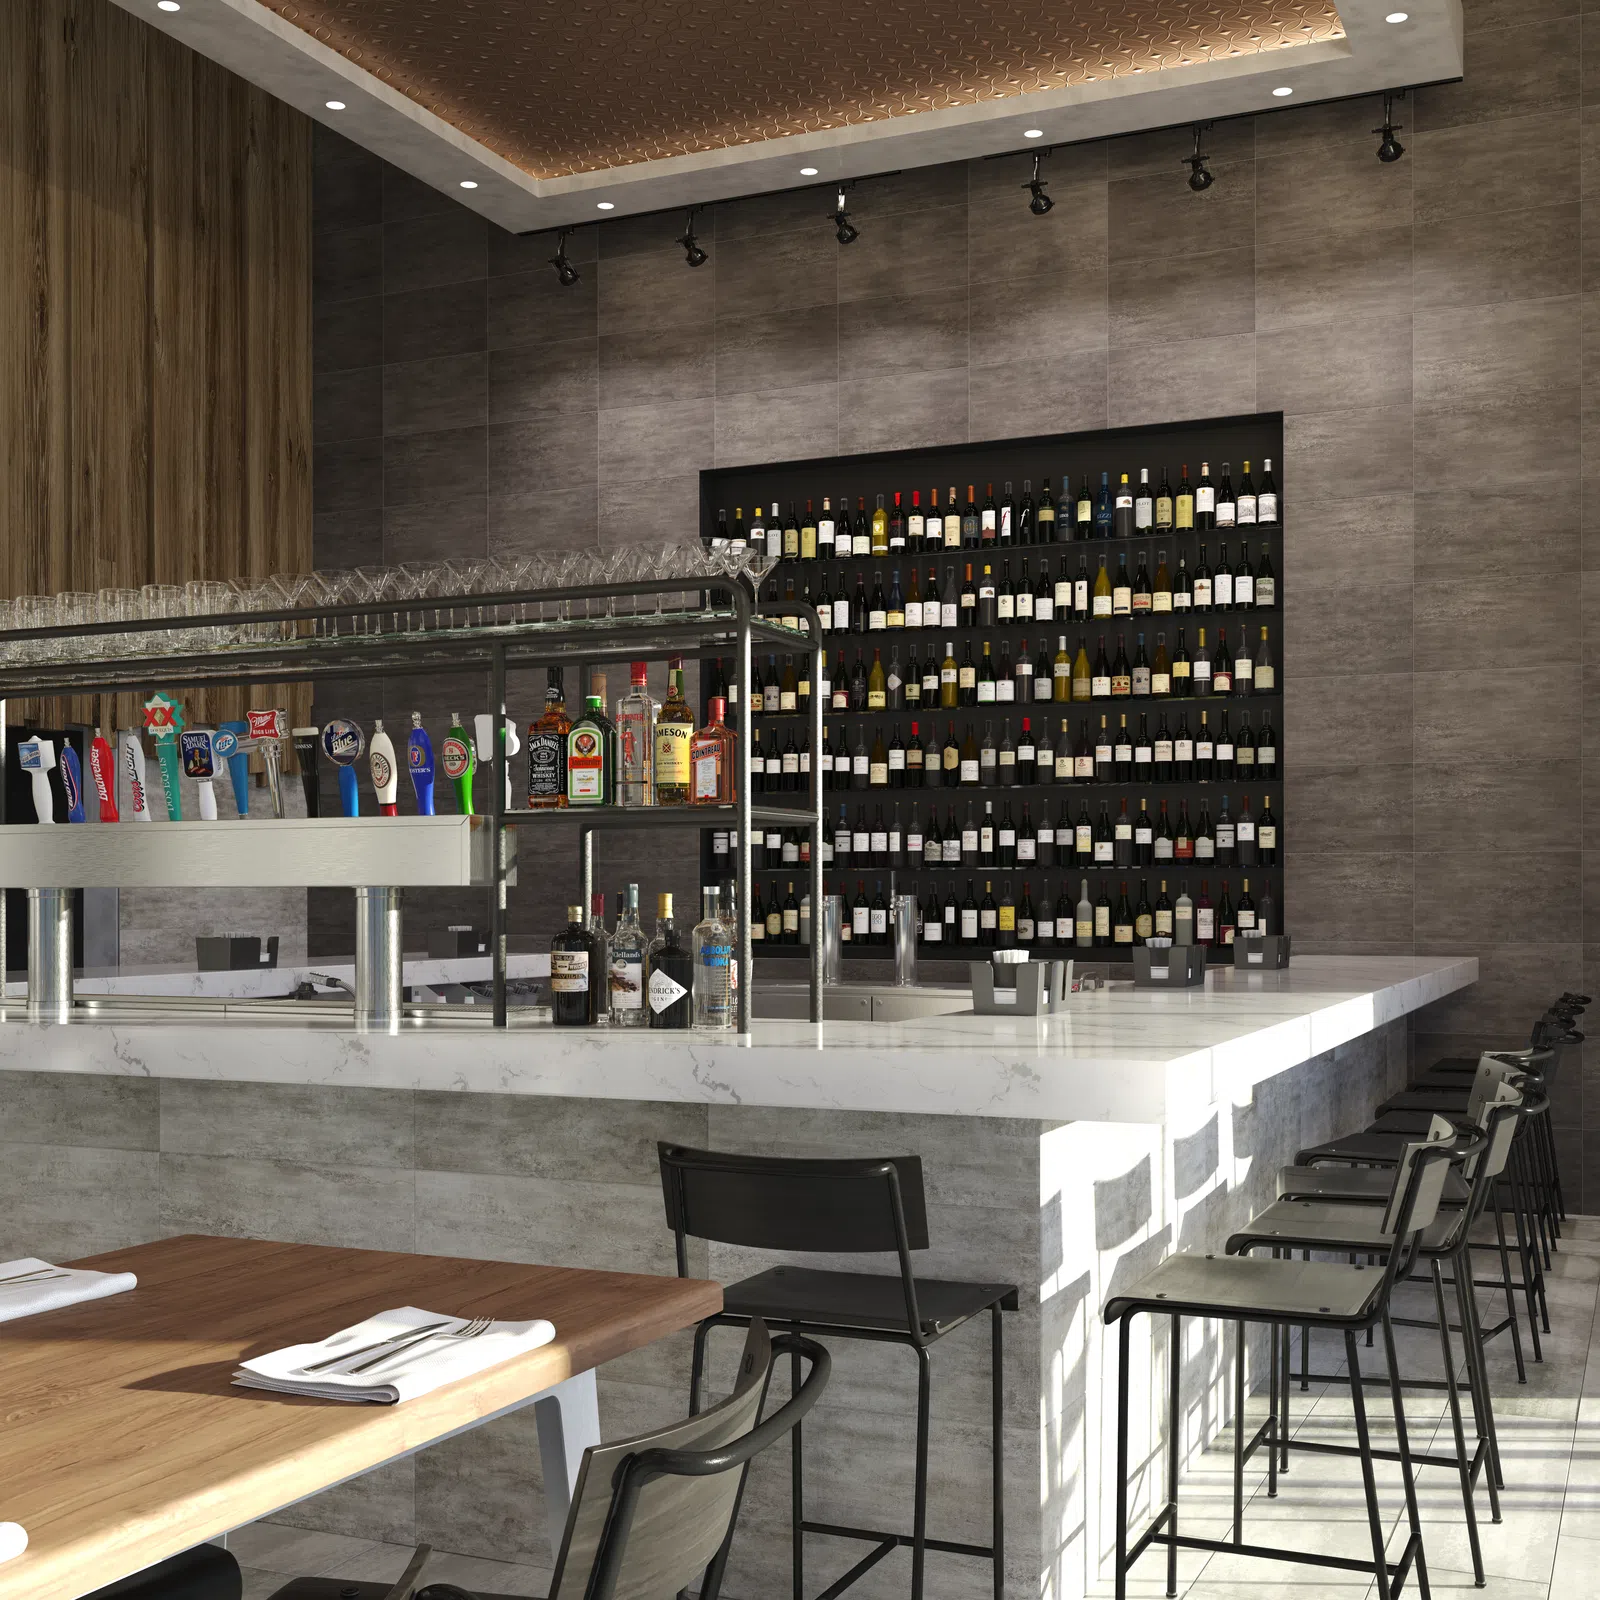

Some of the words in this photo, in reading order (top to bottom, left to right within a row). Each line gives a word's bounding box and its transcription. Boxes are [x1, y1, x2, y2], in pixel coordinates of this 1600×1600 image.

[251, 714, 272, 726] Miller
[183, 734, 208, 745] SAMUEL
[185, 739, 207, 752] ADAMS
[332, 734, 353, 753] Blue
[529, 739, 541, 751] JACK
[541, 737, 559, 751] DANIEL'S
[691, 743, 721, 760] COINTREAU
[61, 759, 70, 786] LIGHT
[90, 745, 108, 801] Budweiser
[158, 757, 171, 788] EQUIS
[66, 786, 74, 807] BUD
[131, 779, 145, 812] Coors
[165, 790, 175, 811] DOS
[700, 945, 731, 954] ABSOLUT
[703, 957, 729, 966] VODKA
